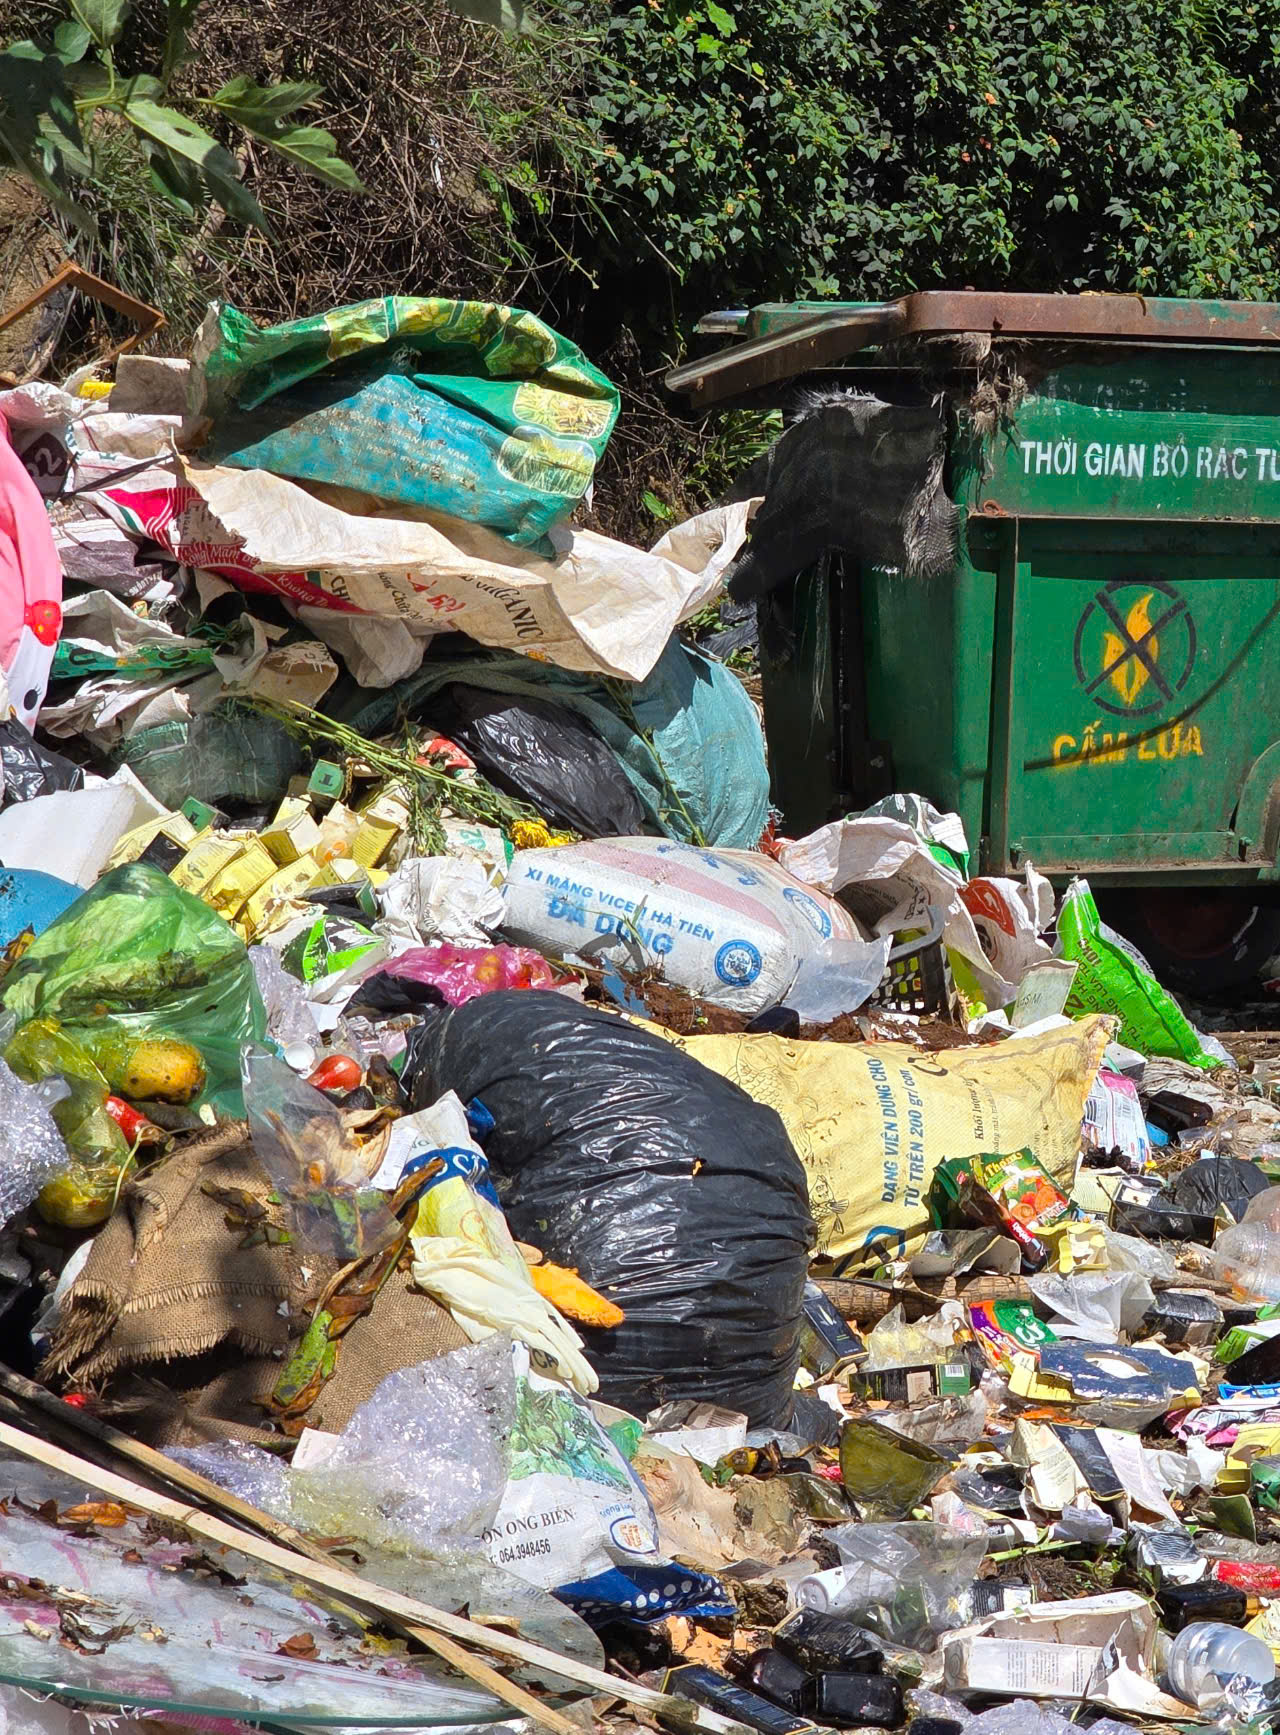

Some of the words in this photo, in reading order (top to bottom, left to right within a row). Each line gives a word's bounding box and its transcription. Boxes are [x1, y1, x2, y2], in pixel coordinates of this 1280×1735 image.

[1084, 441, 1145, 479] GIAN
[525, 867, 543, 881] XI
[867, 1058, 888, 1082] CHO
[908, 1109, 923, 1138] 200
[880, 1121, 899, 1156] VIÊN
[905, 1142, 926, 1182] TRÊN
[881, 1160, 900, 1203] DẠNG
[506, 1515, 538, 1535] ONG
[500, 1538, 551, 1564] 064.3948456
